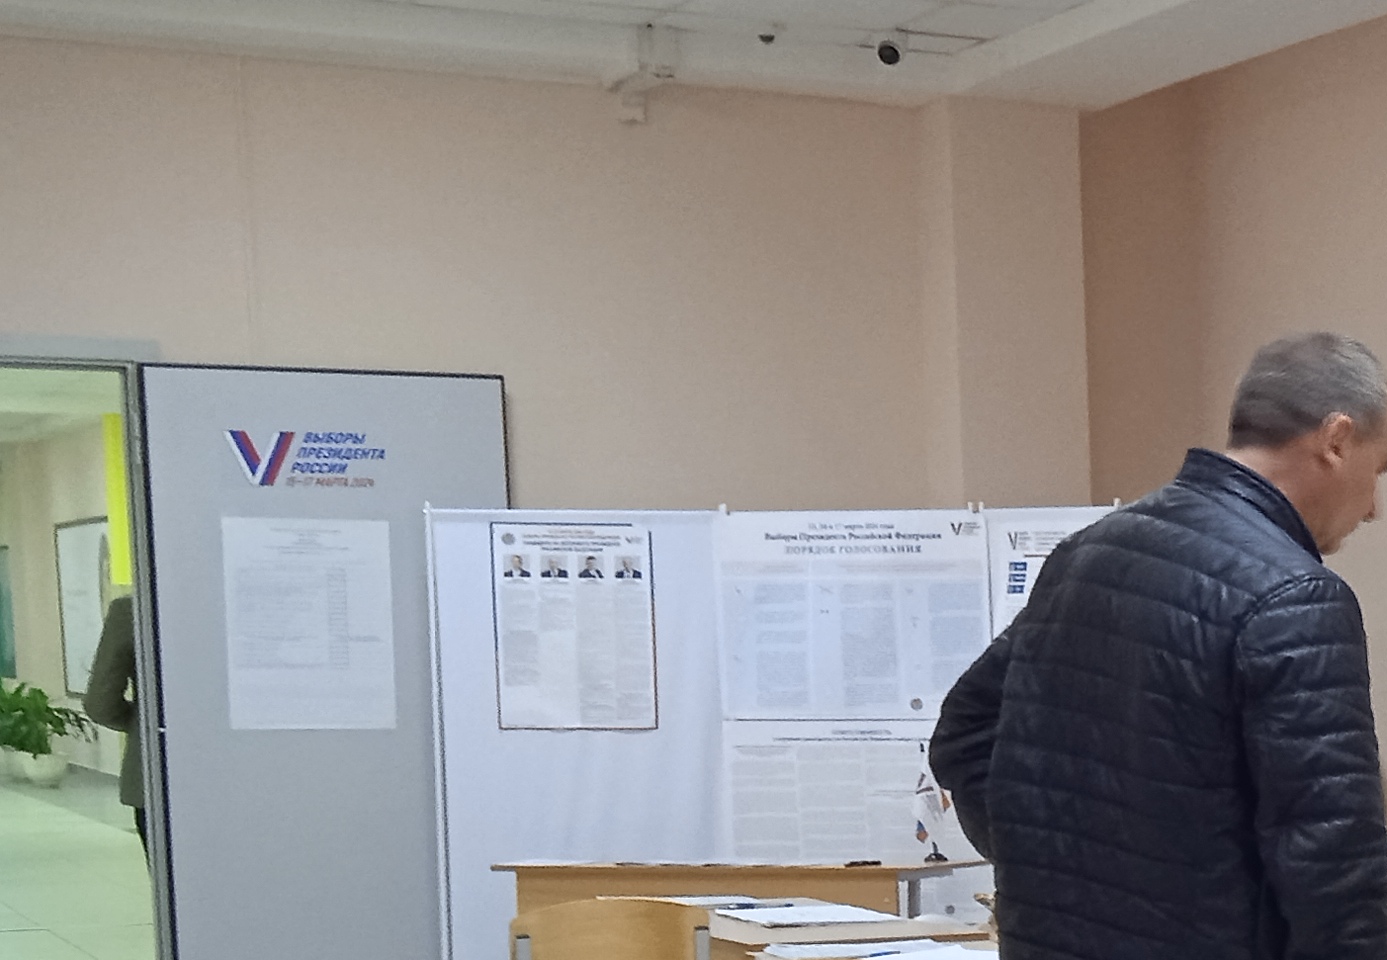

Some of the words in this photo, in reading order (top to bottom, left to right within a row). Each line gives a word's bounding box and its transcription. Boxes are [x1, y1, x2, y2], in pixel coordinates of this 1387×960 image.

[302, 431, 367, 444] ВЫБОРЫ
[297, 446, 386, 461] ПРЕЗИДЕНТА
[290, 461, 349, 474] РОССИИ
